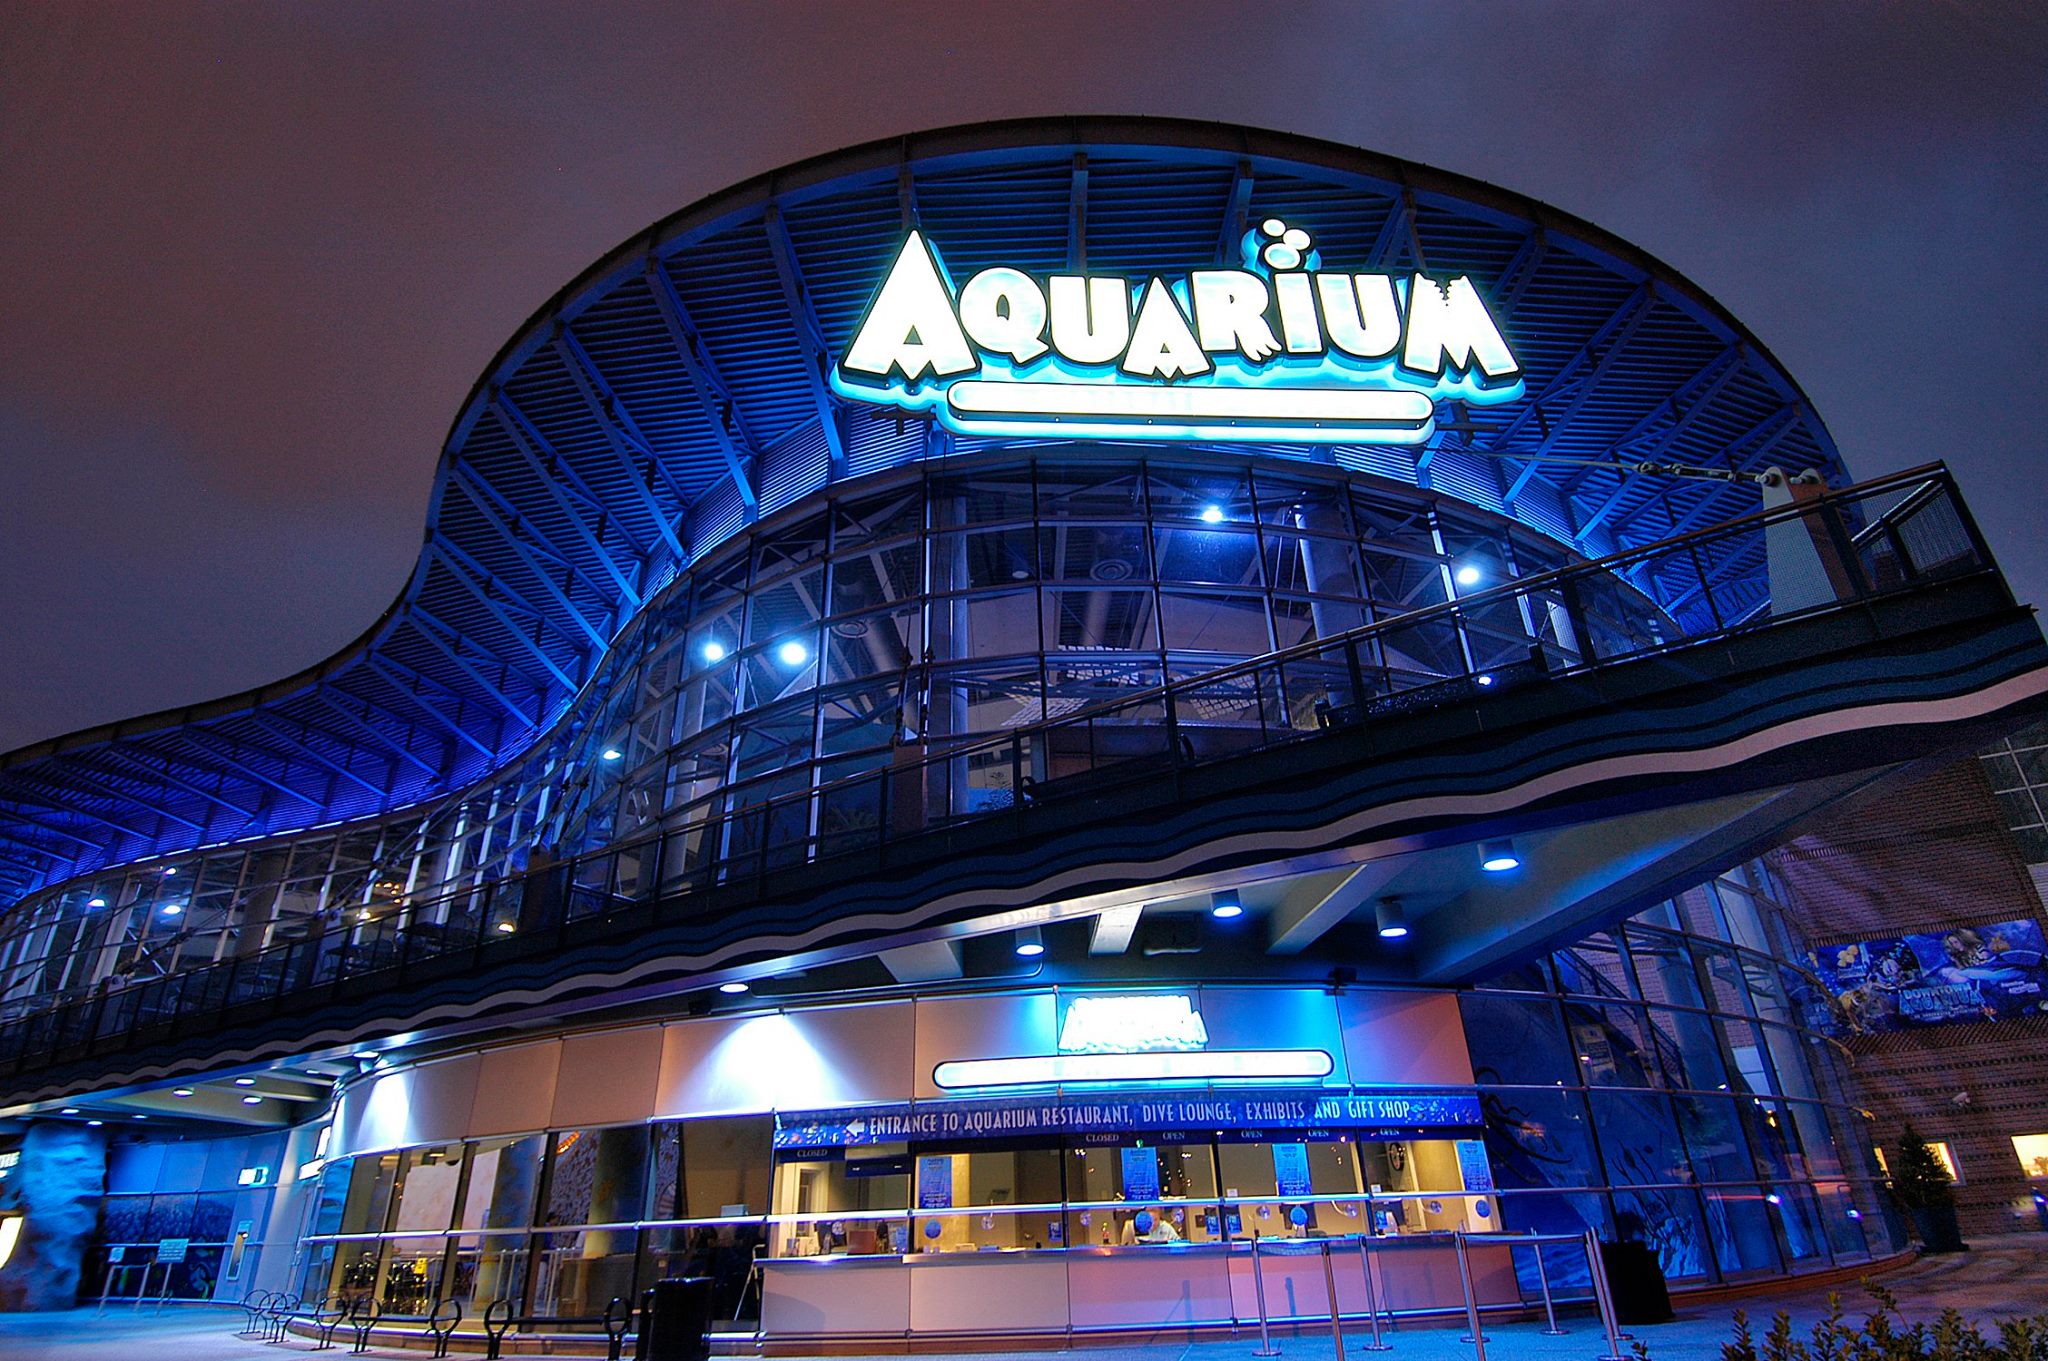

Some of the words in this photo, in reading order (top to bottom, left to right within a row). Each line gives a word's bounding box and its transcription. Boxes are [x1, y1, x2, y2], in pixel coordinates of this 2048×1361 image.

[842, 217, 1524, 383] AQUARIUM
[1903, 983, 1972, 1000] DOWNTOWN
[869, 1114, 937, 1135] ENTRANCE
[942, 1112, 959, 1131] TO
[963, 1108, 1038, 1133] AQUARIUM
[1042, 1105, 1133, 1126] RESTAURANT,
[1143, 1103, 1174, 1123] DIVE
[1179, 1102, 1237, 1123] LOUNGE,
[1245, 1102, 1305, 1120] EXHIBITS
[1314, 1101, 1341, 1119] AND
[1348, 1101, 1375, 1118] GIFT
[1378, 1100, 1410, 1118] SHOP
[1162, 1130, 1186, 1140] OPEN
[1240, 1129, 1264, 1139] OPEN
[1307, 1128, 1330, 1138] OPEN
[1379, 1127, 1400, 1137] OPEN
[1085, 1133, 1120, 1143] CLOSED
[796, 1148, 829, 1158] CLOSED
